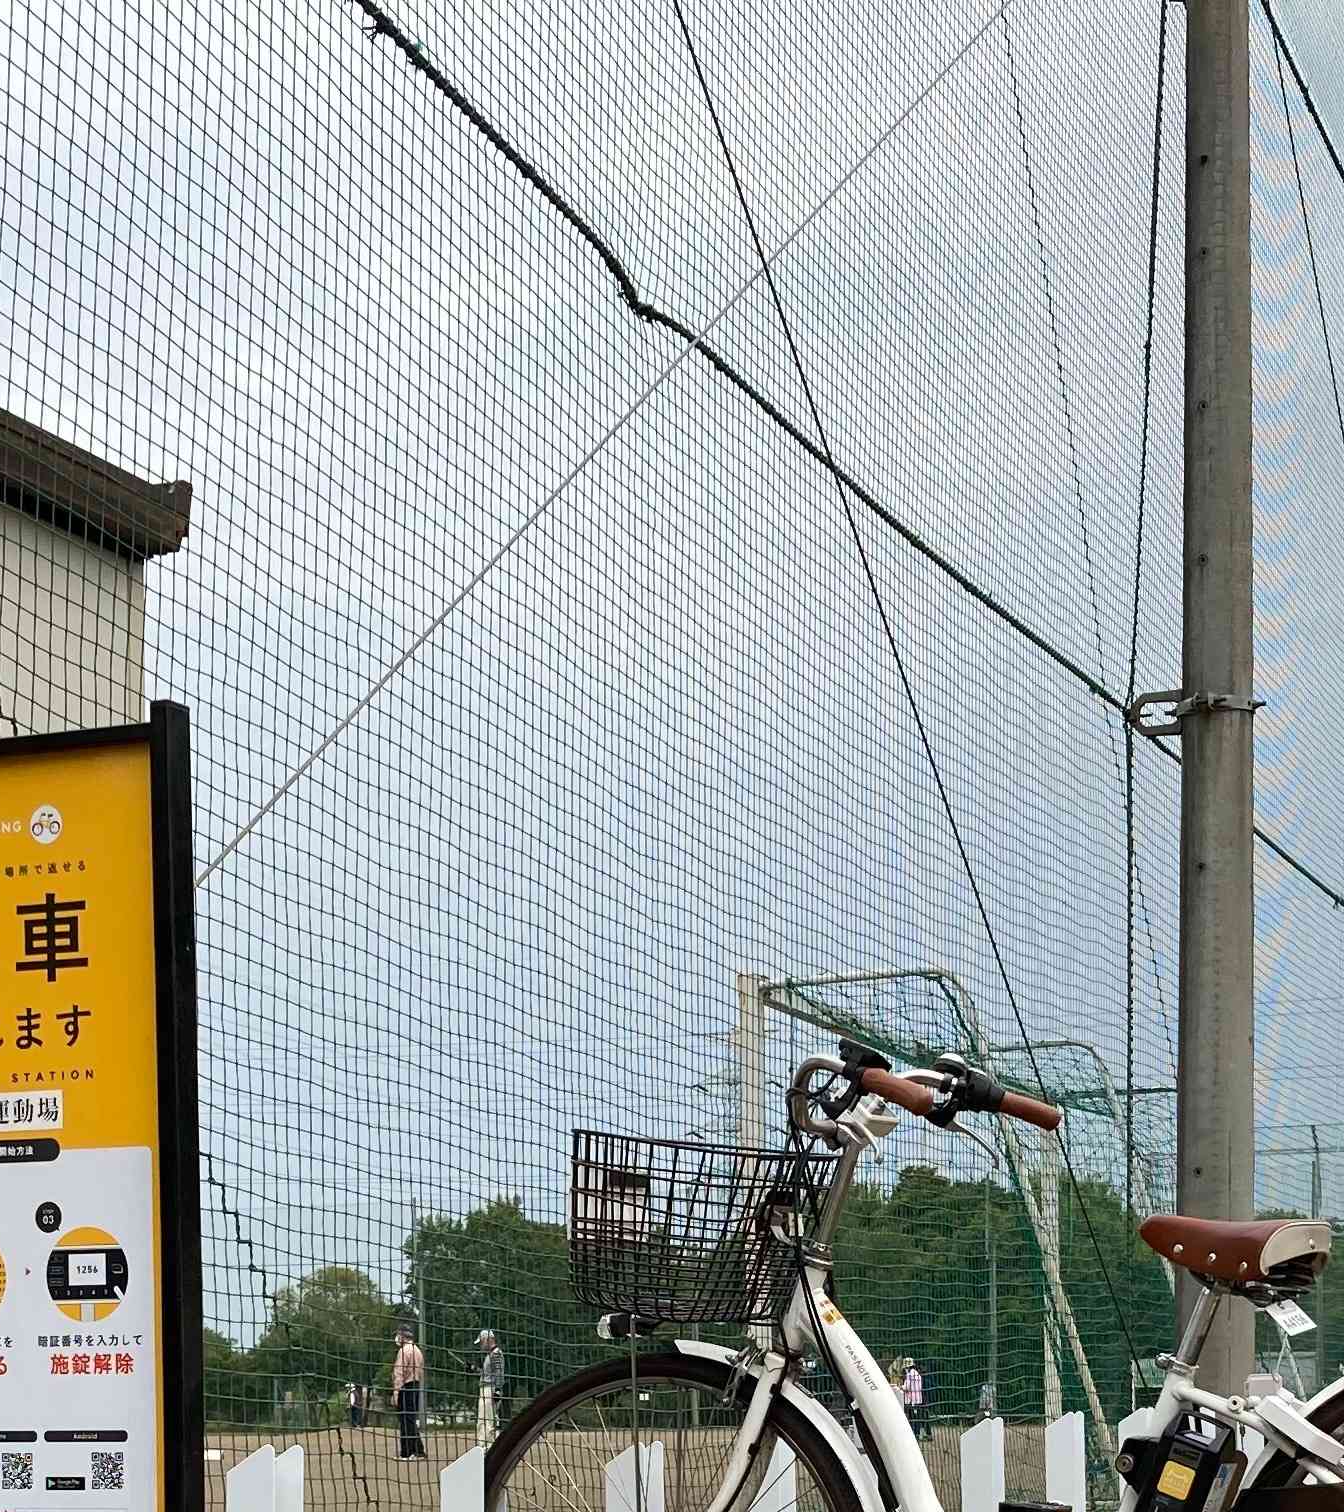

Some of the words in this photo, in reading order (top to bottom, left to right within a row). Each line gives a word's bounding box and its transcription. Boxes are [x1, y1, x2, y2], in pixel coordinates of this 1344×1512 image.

[11, 1069, 96, 1084] STATION
[42, 1215, 54, 1225] 03
[76, 1265, 98, 1275] 1256
[38, 1334, 143, 1348] 暗証番号を入力して
[50, 1353, 135, 1375] 施錠解除
